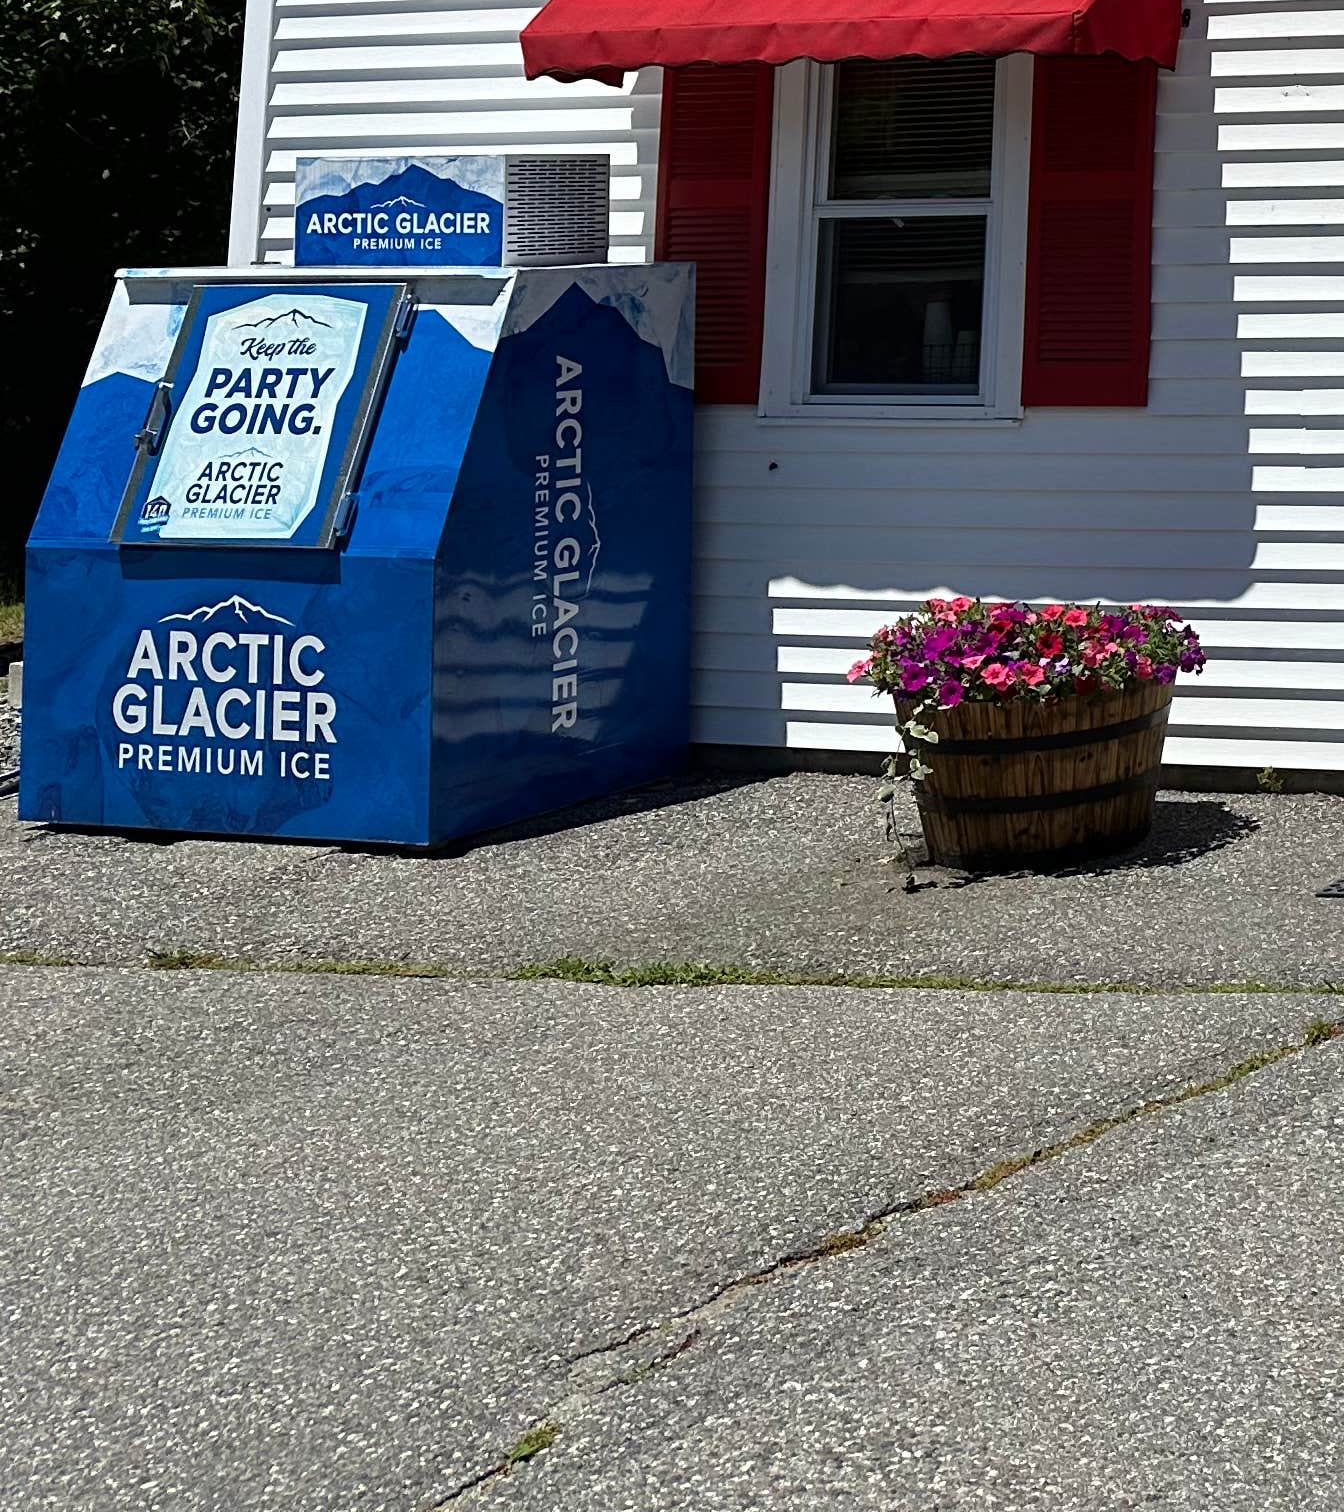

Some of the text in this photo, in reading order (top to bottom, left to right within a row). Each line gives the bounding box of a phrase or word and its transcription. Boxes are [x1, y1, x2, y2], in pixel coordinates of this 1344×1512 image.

[306, 212, 491, 235] ARCTIC GLACIER
[353, 238, 442, 250] PREMIUM ICE
[240, 337, 318, 361] Keep the
[204, 367, 336, 399] PARTY
[190, 402, 322, 435] GOING.
[197, 461, 284, 482] ARCTIC
[185, 483, 281, 505] GLACIER
[182, 507, 273, 520] PREMIUM ICE
[531, 454, 550, 637] PREMIUM ICE
[551, 355, 583, 733] ARCTIC GLACIER
[126, 629, 326, 687] ARCTIC
[112, 683, 338, 744] GLACIER
[118, 743, 330, 779] PREMIUM ICE
